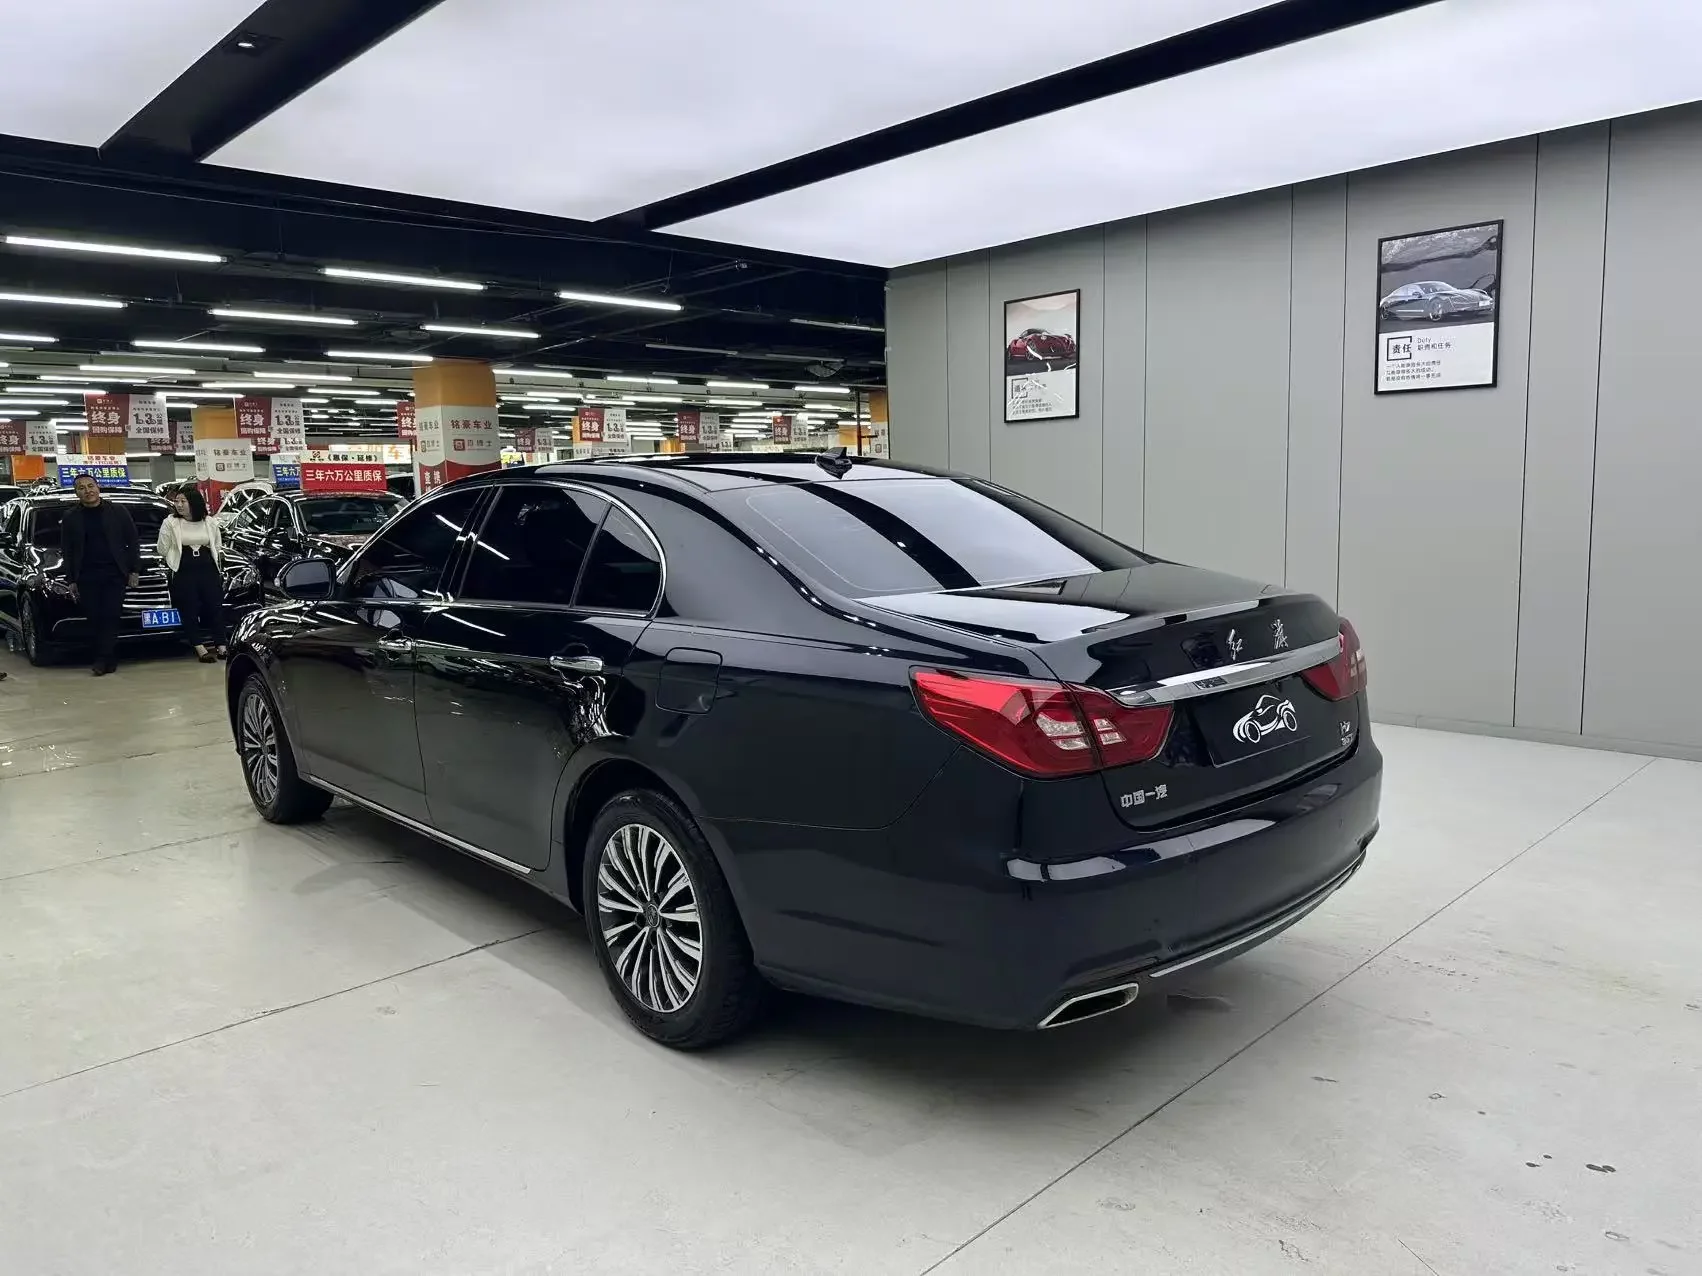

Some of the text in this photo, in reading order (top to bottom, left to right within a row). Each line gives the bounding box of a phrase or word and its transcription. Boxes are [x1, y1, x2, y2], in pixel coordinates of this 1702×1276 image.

[1393, 344, 1411, 353] 责任
[92, 411, 120, 424] 终身
[240, 413, 264, 426] 终身
[402, 416, 415, 428] 终
[61, 467, 127, 478] 三年六万公里质保
[305, 469, 382, 482] 三年六万公里质保
[1120, 784, 1168, 808] 中国一汽
